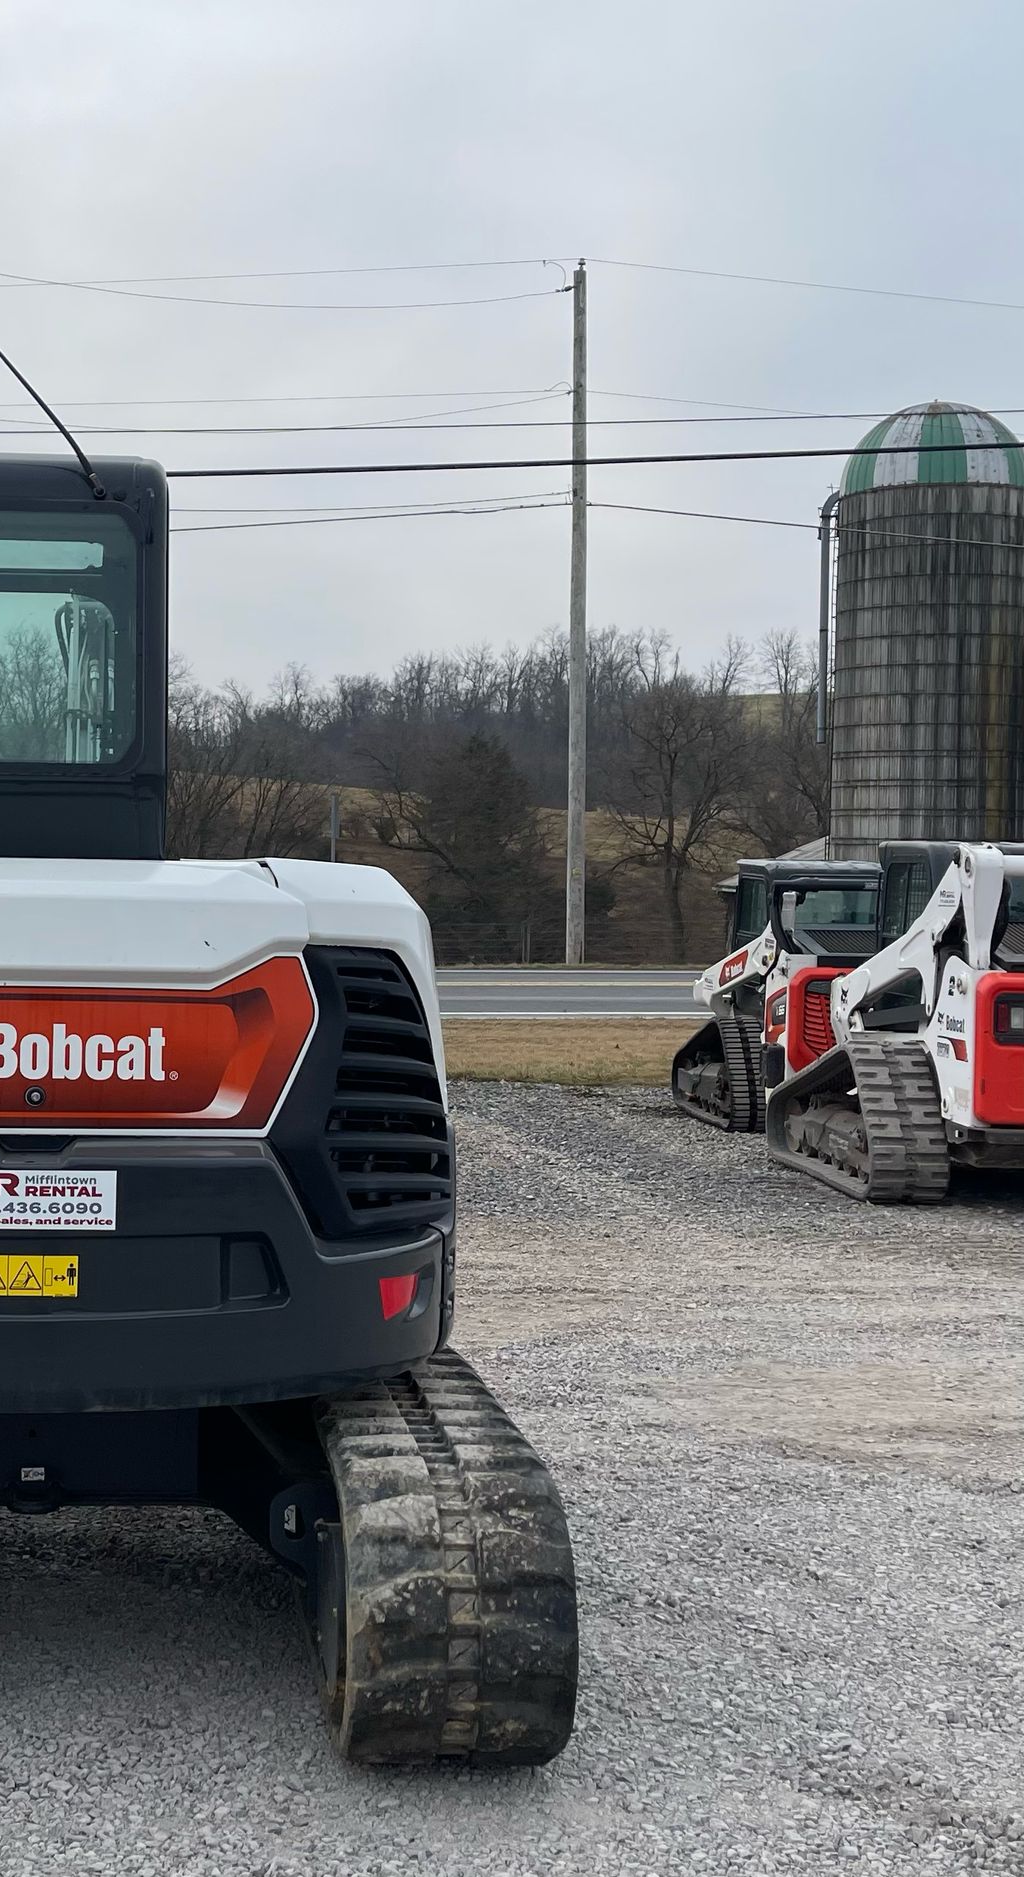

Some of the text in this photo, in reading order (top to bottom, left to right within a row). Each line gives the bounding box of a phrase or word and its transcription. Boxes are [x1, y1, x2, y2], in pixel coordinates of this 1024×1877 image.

[946, 1015, 965, 1033] Bobcat
[25, 1175, 97, 1185] Mifflintown
[25, 1186, 102, 1197] RENTAL
[35, 1216, 61, 1225] and
[63, 1217, 113, 1226] service
